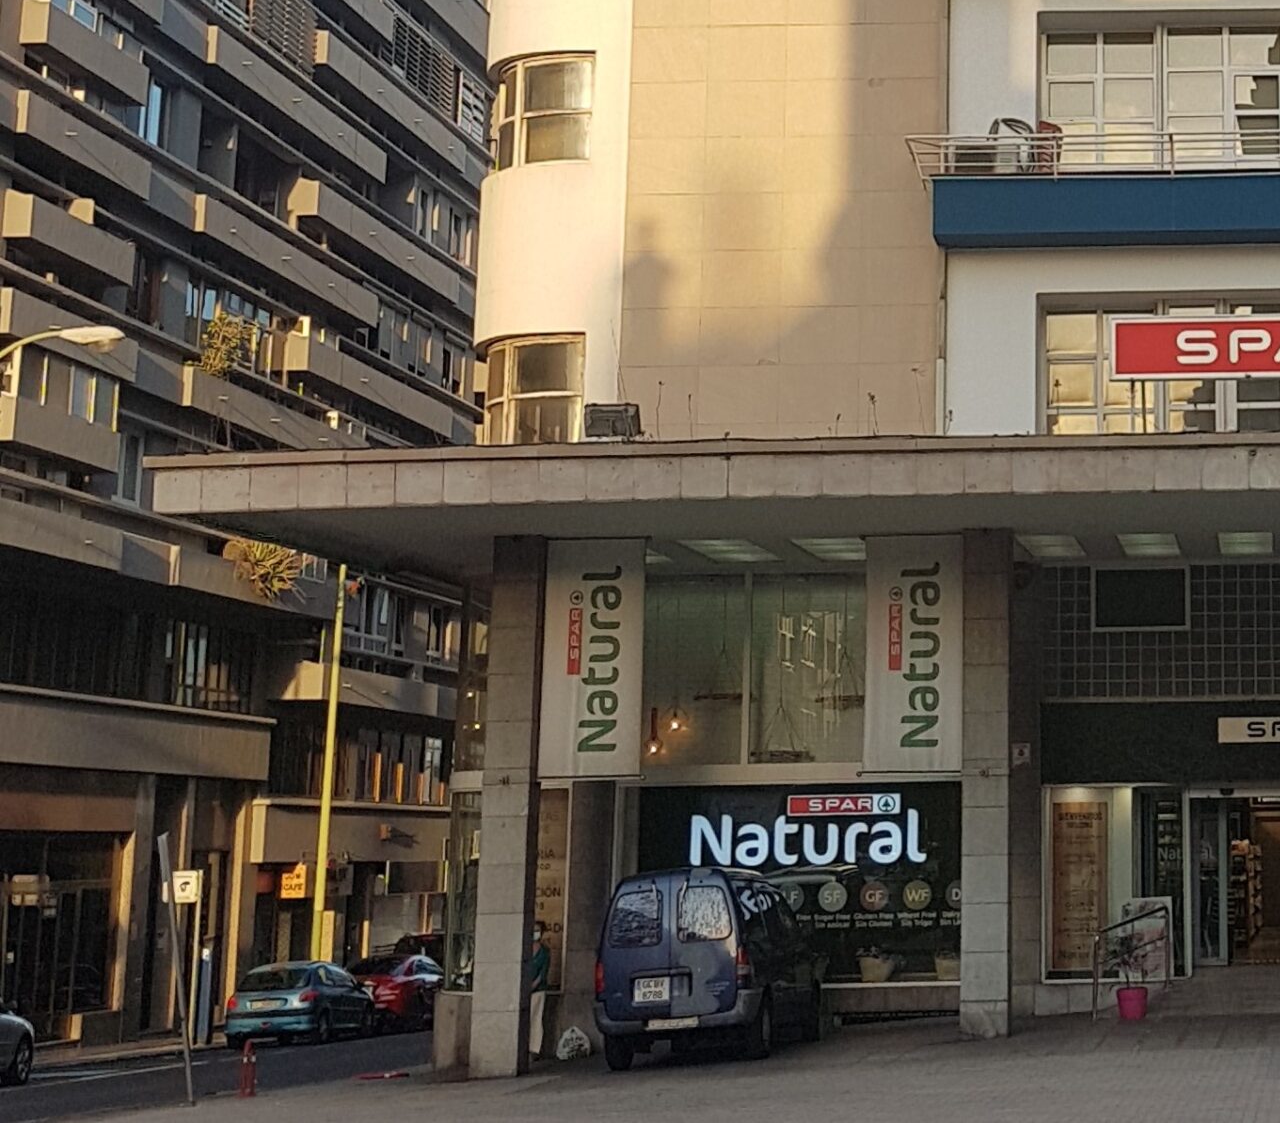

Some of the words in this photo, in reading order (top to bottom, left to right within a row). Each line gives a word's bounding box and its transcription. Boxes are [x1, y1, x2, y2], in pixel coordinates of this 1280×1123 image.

[569, 608, 582, 660] SPAR
[890, 605, 902, 656] SPAR
[899, 561, 941, 748] Natural
[577, 565, 622, 753] Natural
[808, 798, 872, 812] SPAR
[689, 808, 927, 867] Natural
[824, 890, 841, 903] SF
[865, 889, 884, 902] GF
[905, 888, 931, 901] WF
